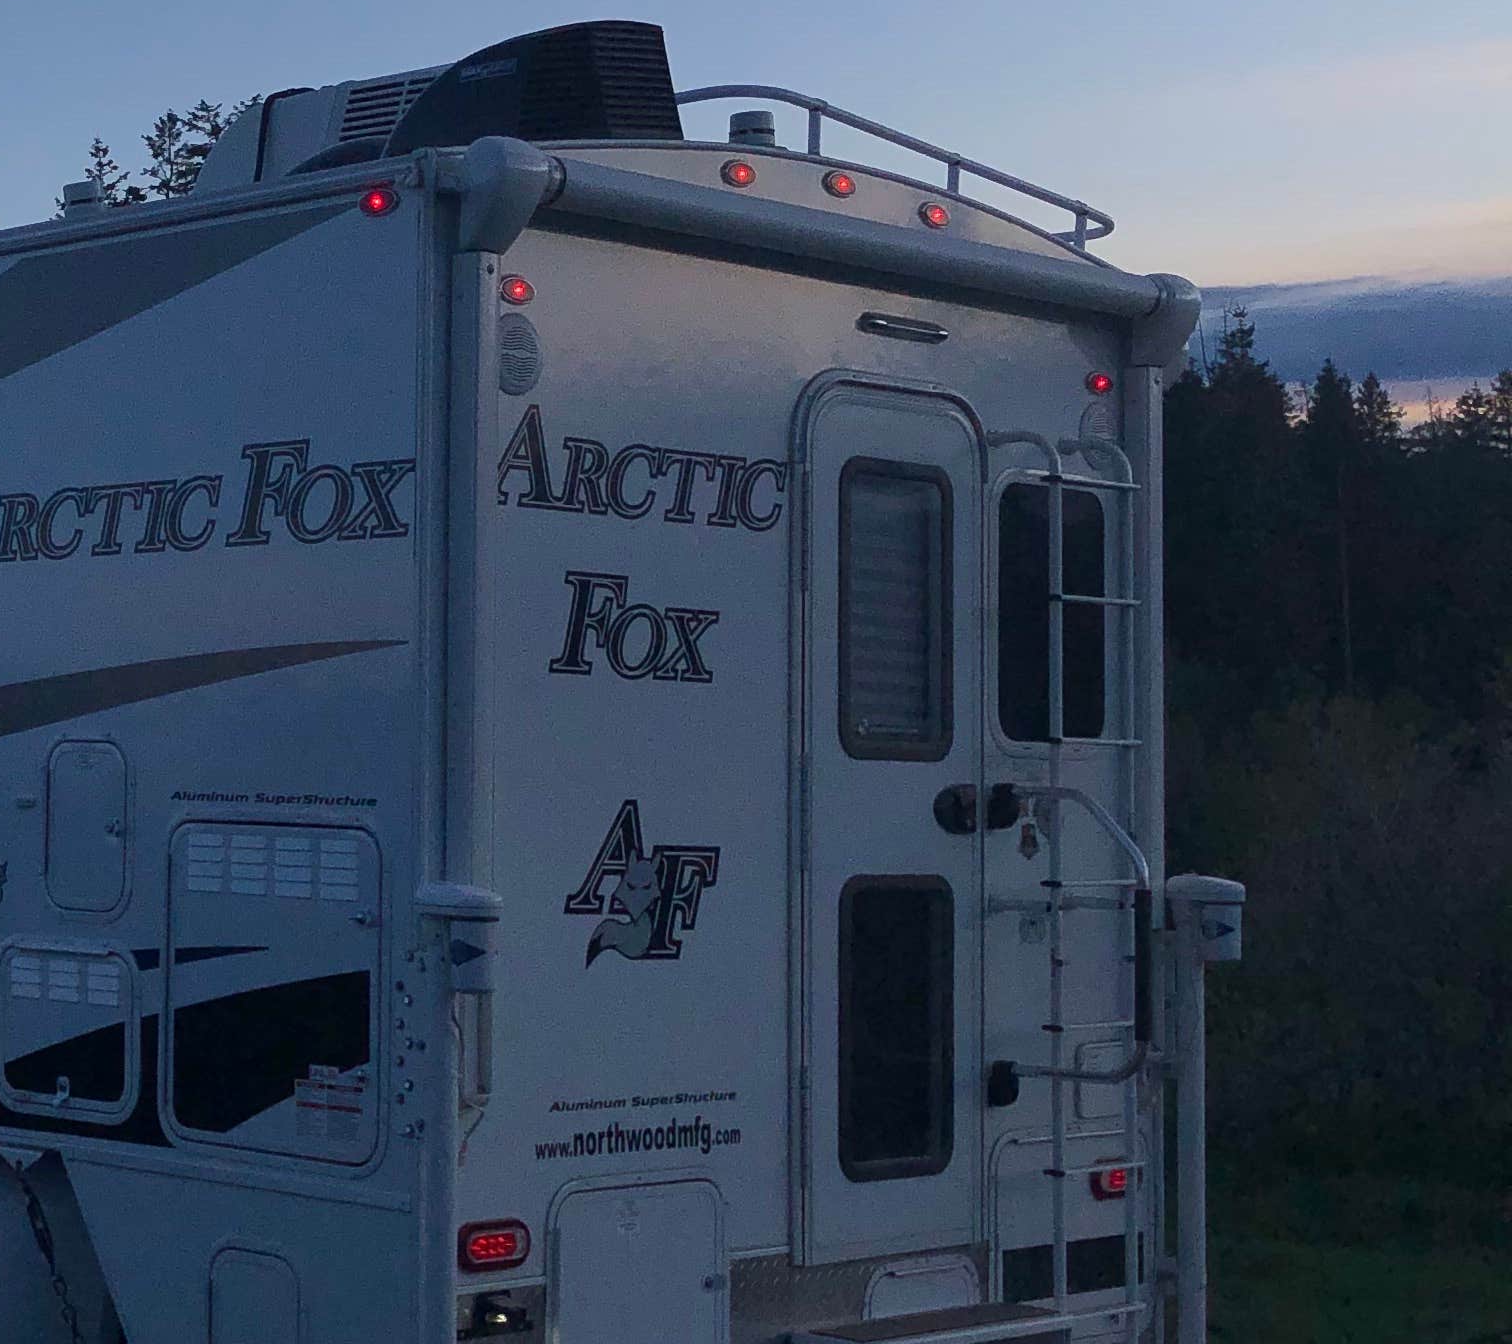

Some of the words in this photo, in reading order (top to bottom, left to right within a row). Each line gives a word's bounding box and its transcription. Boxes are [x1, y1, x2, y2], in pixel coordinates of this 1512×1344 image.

[225, 438, 417, 548] FOX
[496, 404, 788, 532] ARCTIC
[548, 570, 720, 684] FOX
[170, 790, 249, 803] Aluminum
[254, 791, 378, 807] SuperStructure
[534, 1114, 742, 1160] www.northwoodmfg.com
[548, 1097, 627, 1113] Aluminum
[630, 1090, 738, 1109] SuperStructure
